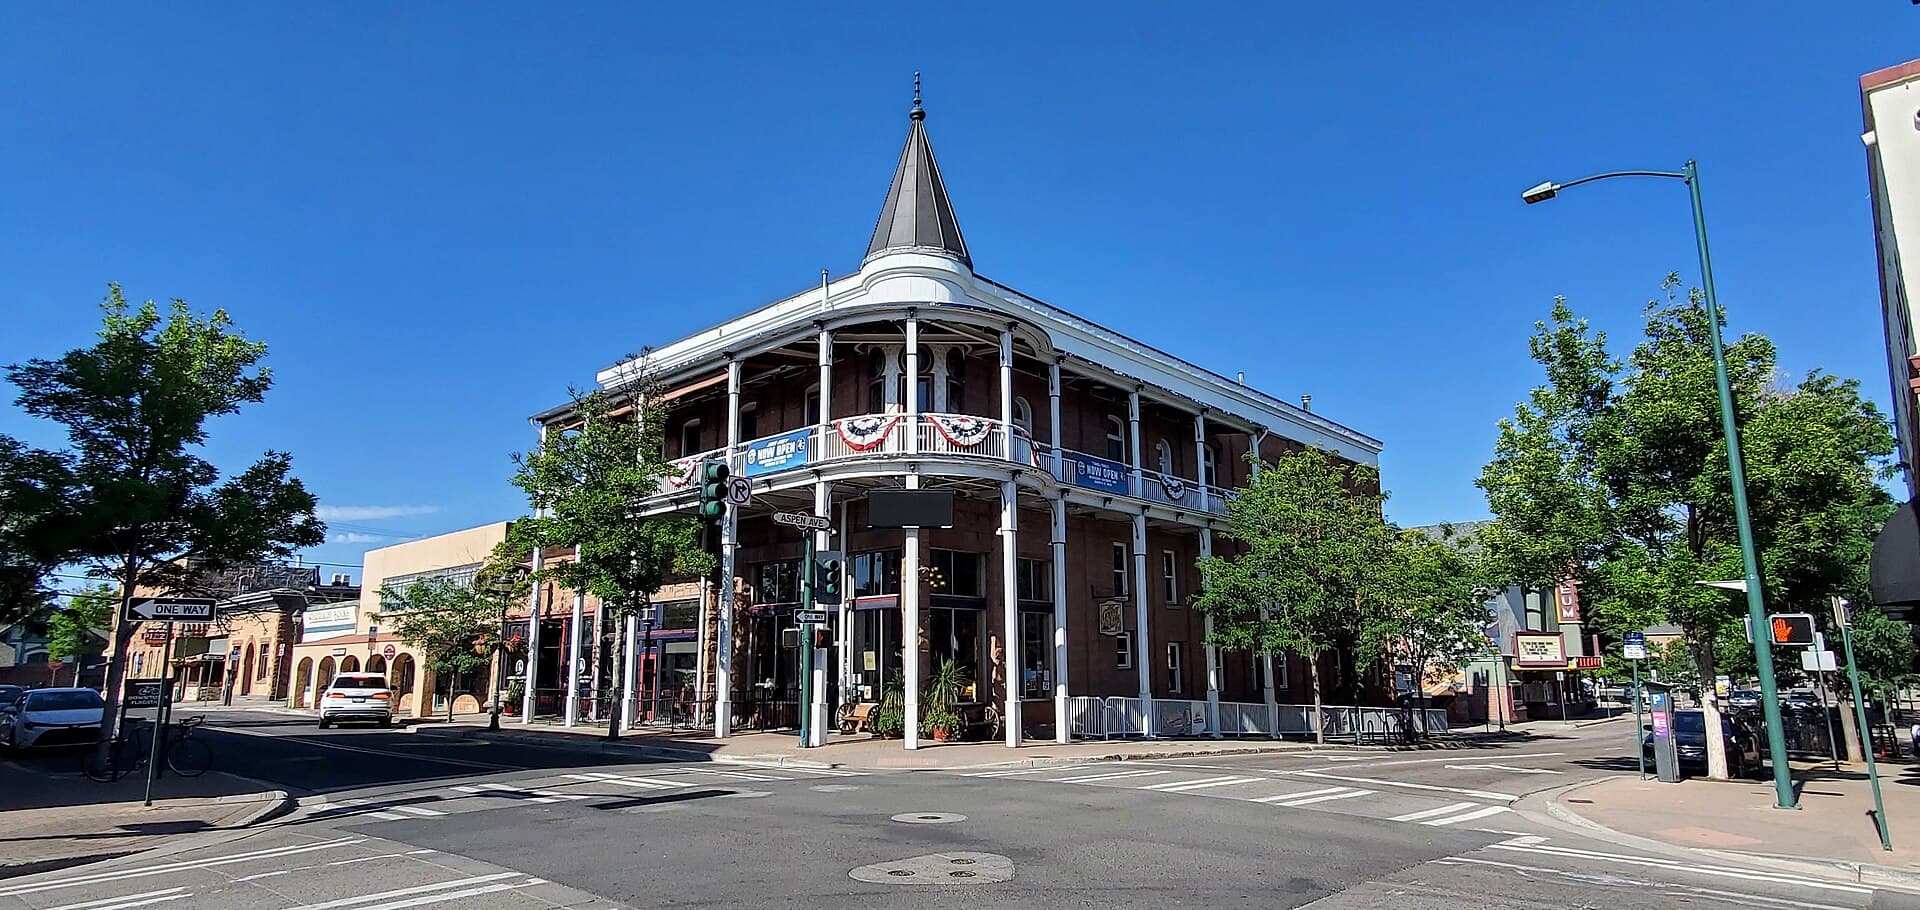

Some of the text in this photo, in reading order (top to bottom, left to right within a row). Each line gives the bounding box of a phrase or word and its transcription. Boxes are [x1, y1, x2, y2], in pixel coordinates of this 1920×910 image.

[776, 441, 796, 456] OPEN
[781, 514, 824, 527] ASPEN AVE
[155, 605, 206, 615] ONE WAY
[1652, 693, 1661, 705] P
